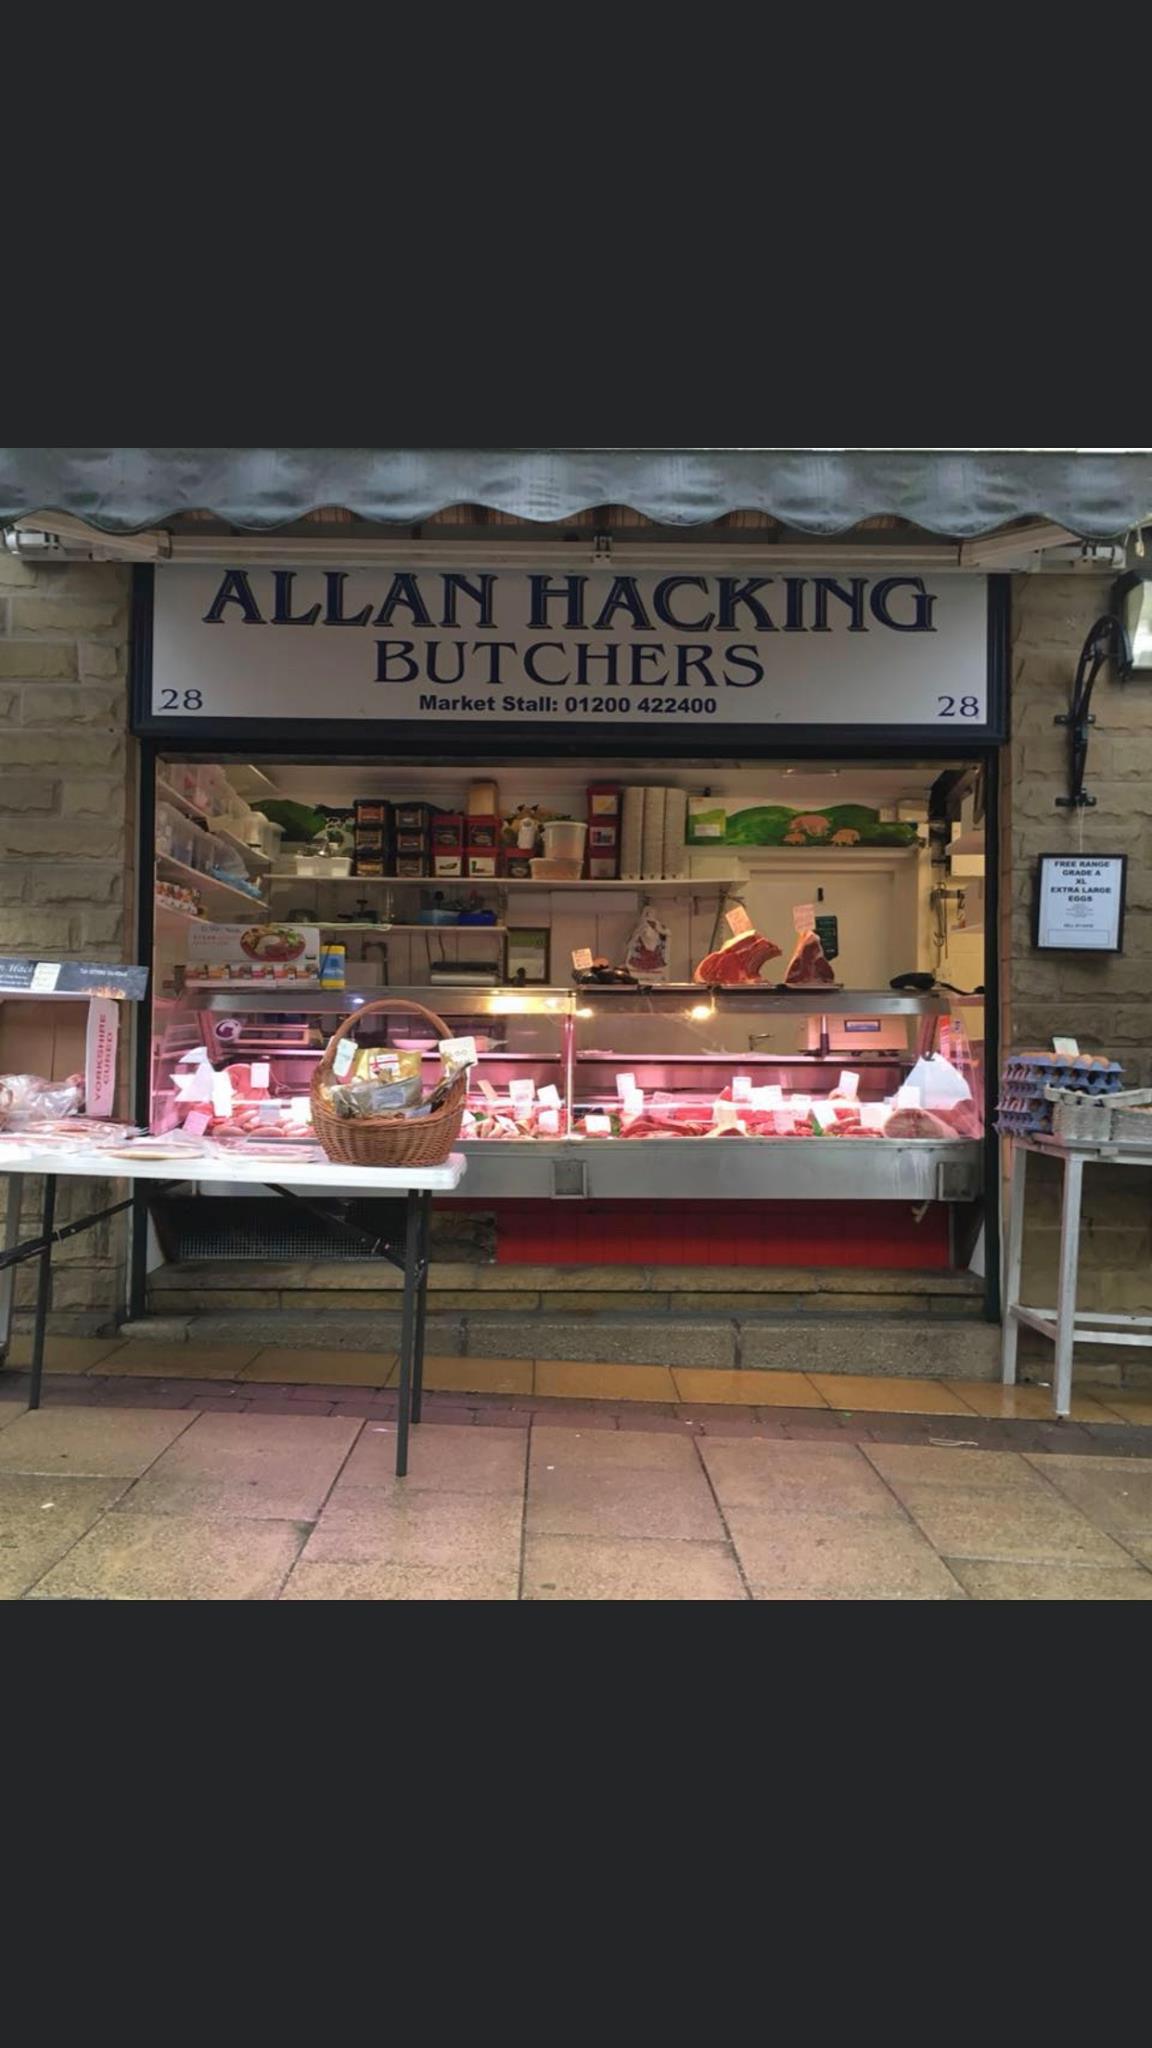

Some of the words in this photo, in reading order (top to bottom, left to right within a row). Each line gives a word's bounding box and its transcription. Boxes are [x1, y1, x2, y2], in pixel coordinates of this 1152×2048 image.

[202, 571, 499, 629] ALLAN
[526, 574, 938, 633] HACKING
[374, 640, 764, 688] BUTCHERS
[160, 688, 203, 711] 28
[420, 695, 495, 711] Market
[502, 696, 558, 712] Stall:
[565, 697, 631, 713] 01200
[637, 698, 717, 713] 422400
[937, 696, 980, 718] 28
[94, 1014, 106, 1101] YORKSHIRE
[104, 1031, 112, 1084] CURED
